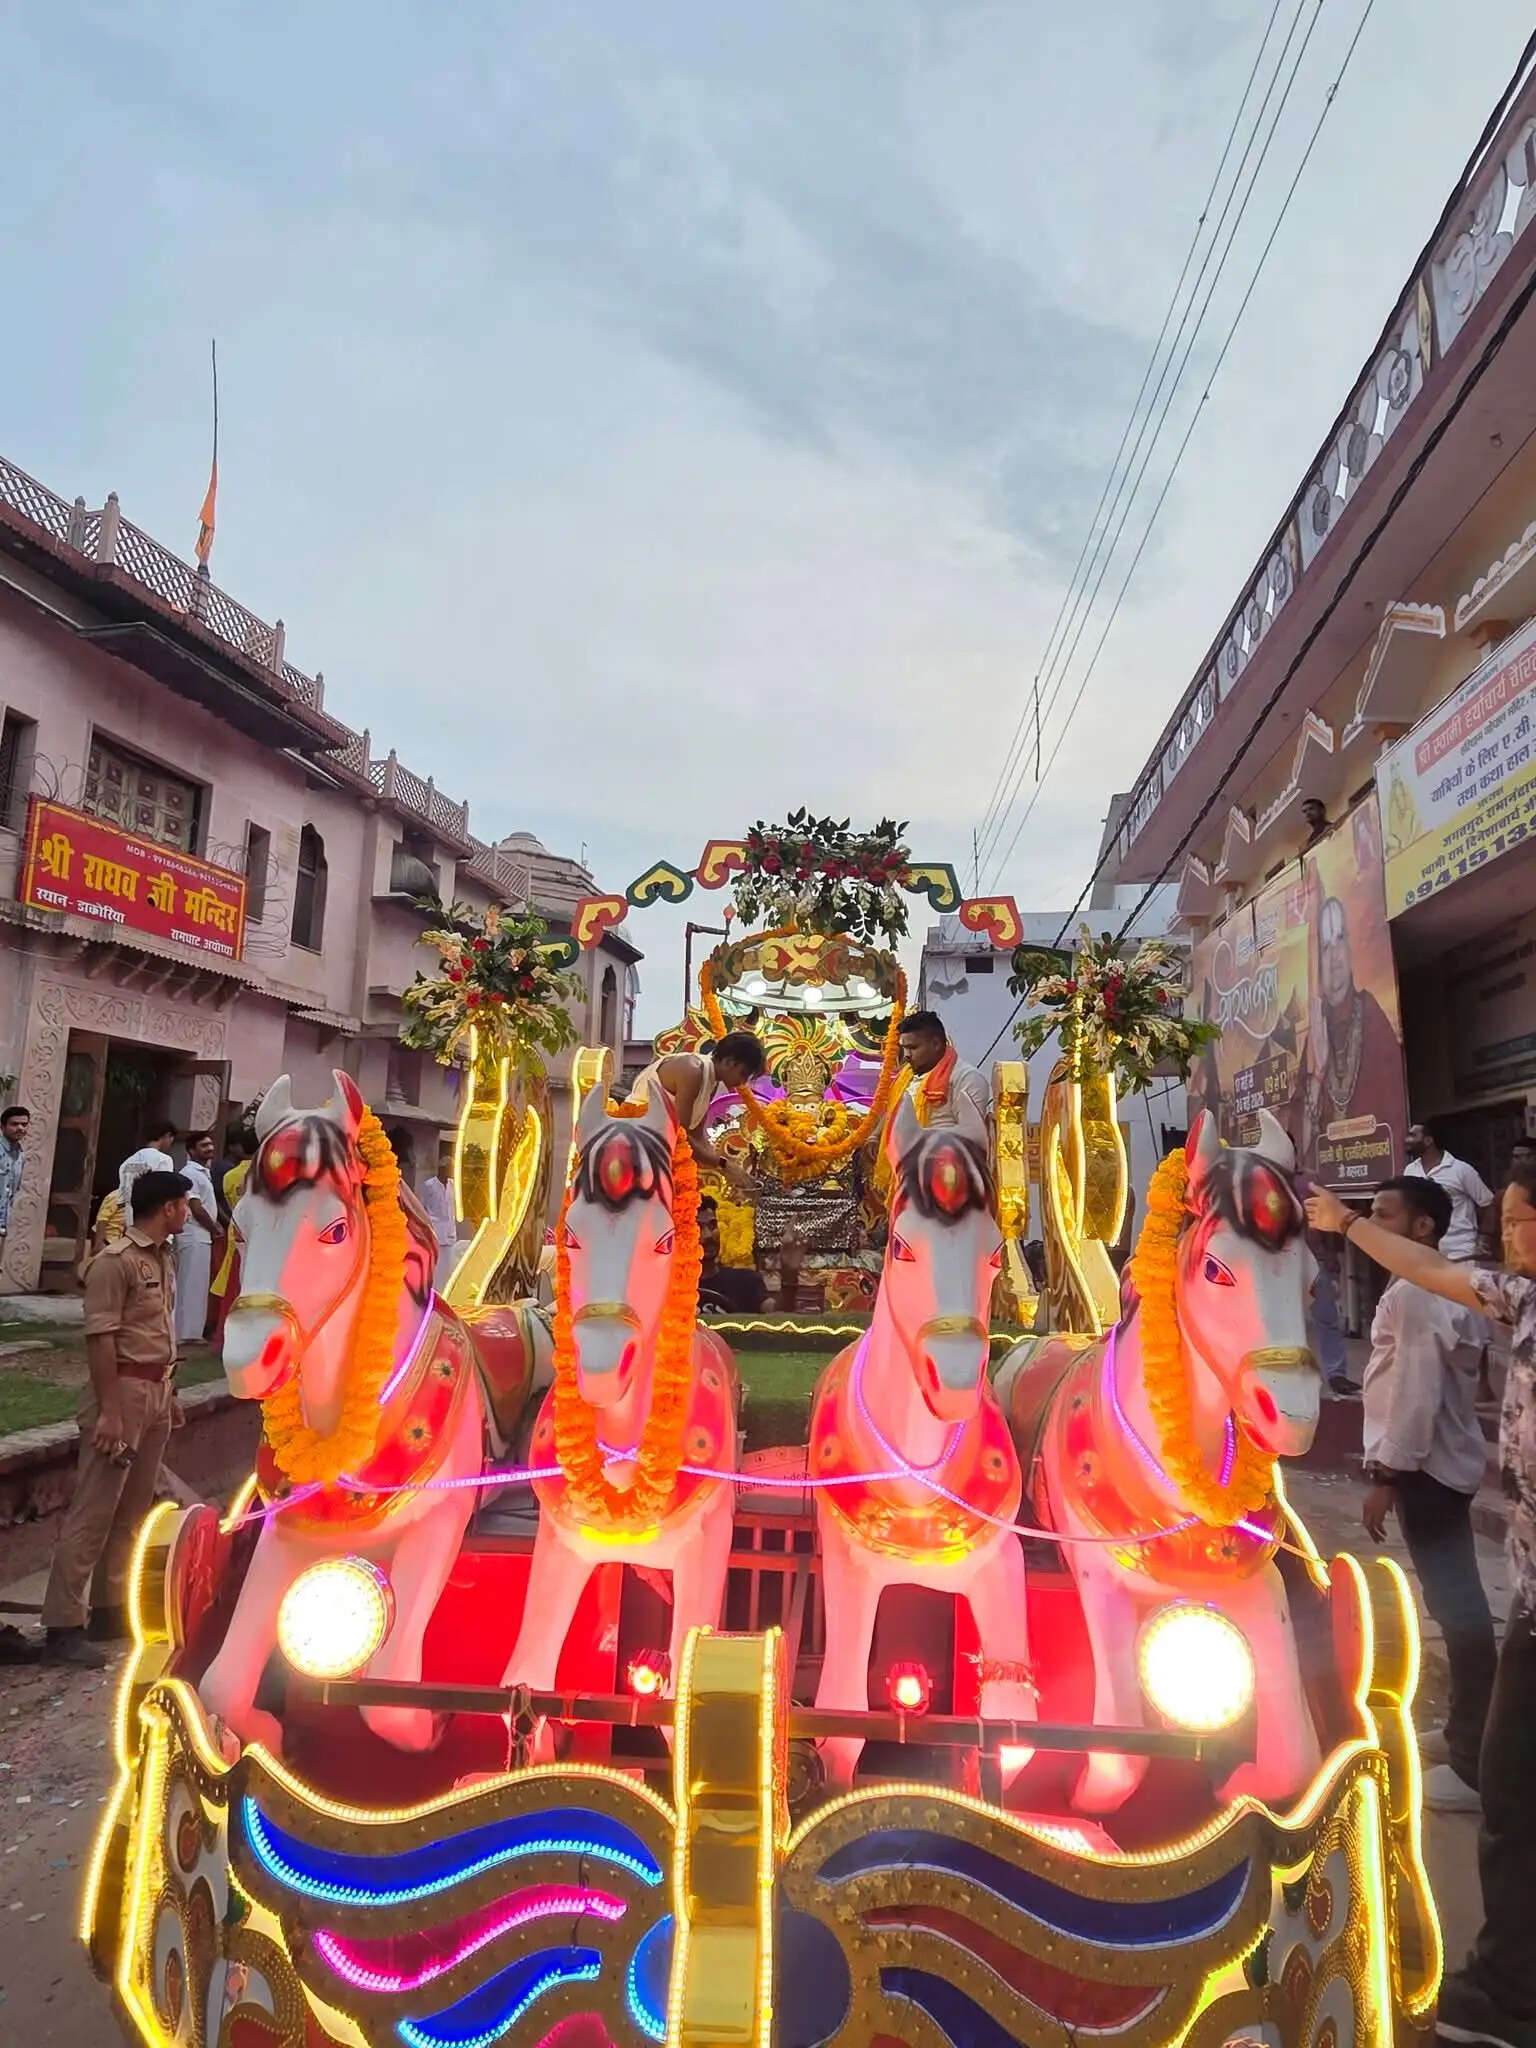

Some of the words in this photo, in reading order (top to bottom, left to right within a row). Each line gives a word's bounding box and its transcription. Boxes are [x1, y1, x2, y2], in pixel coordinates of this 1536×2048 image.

[1431, 768, 1462, 802] यात्रियों
[1465, 758, 1476, 777] के
[1478, 741, 1499, 769] लिए
[1458, 785, 1477, 807] तथा
[1480, 764, 1504, 789] कथा
[1507, 744, 1530, 772] हाल
[40, 832, 75, 882] श्री
[82, 852, 140, 902] राघव
[147, 871, 179, 915] जी
[183, 887, 239, 934] मन्दिर
